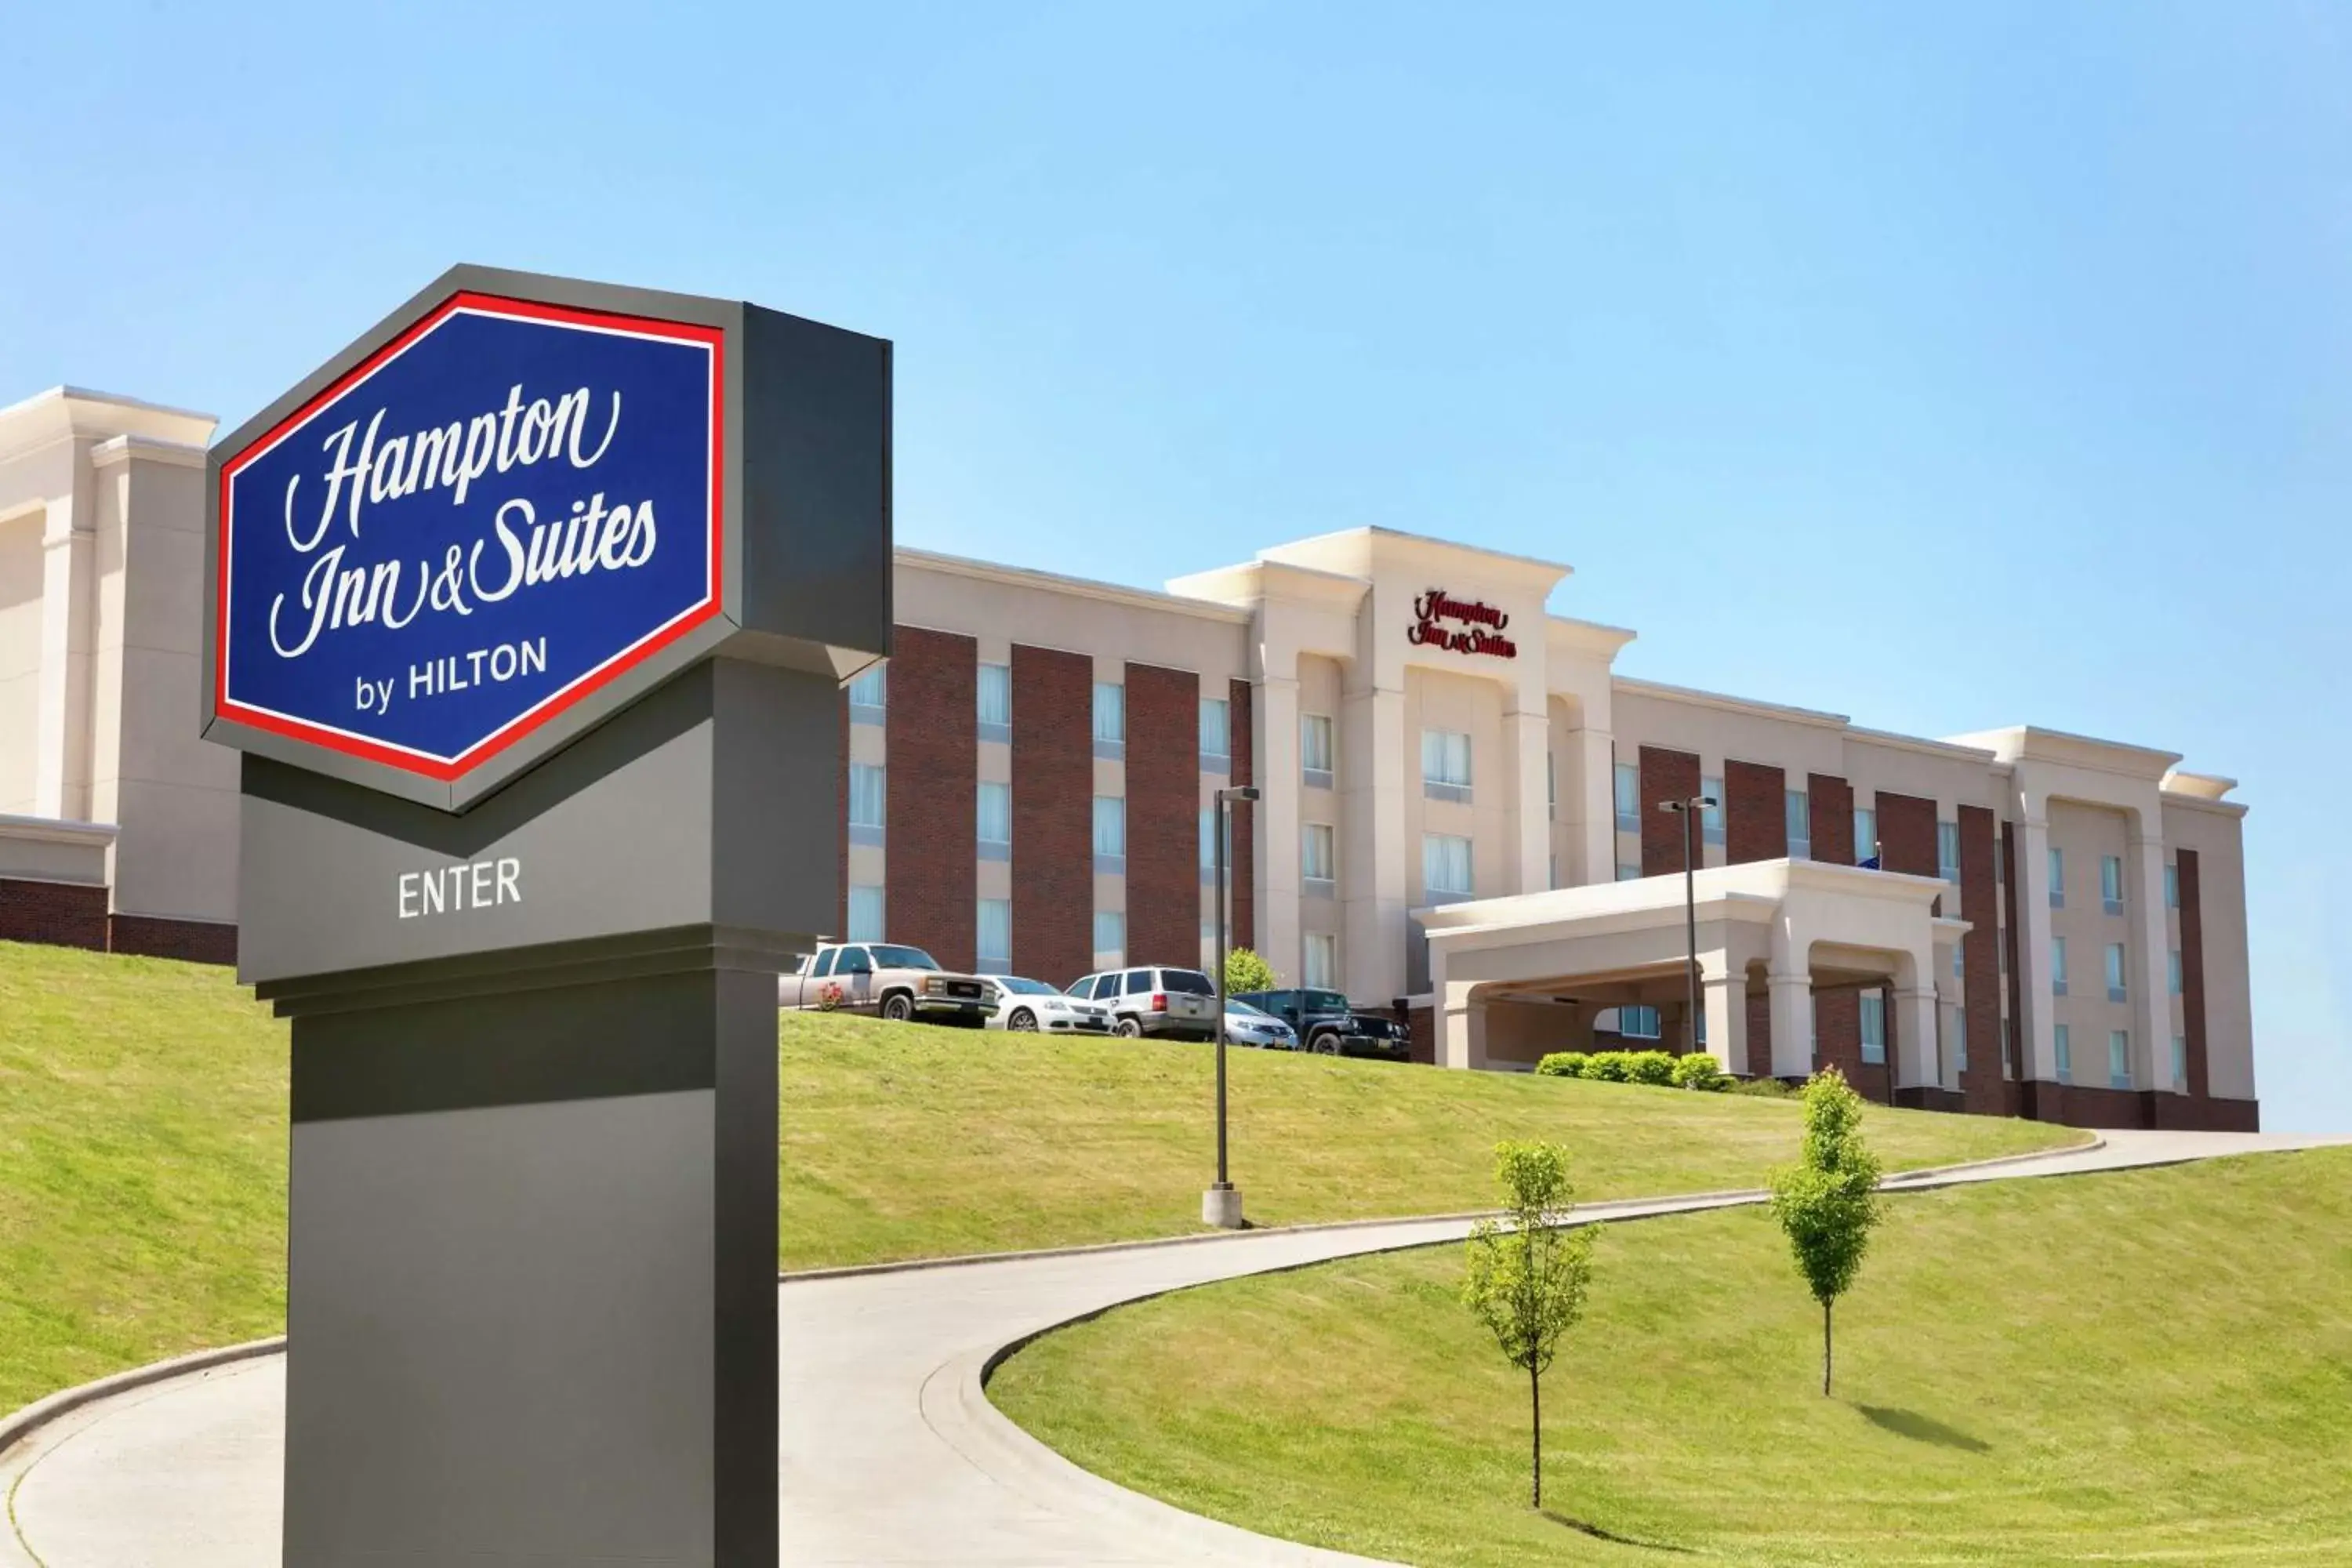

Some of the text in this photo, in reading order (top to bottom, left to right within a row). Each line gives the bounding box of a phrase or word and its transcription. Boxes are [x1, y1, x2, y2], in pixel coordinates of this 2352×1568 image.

[285, 383, 621, 553] Hampton
[270, 492, 657, 658] Inn & Suites
[1414, 590, 1508, 630] Hampton
[357, 637, 546, 715] by HILTON
[398, 856, 522, 919] ENTER
